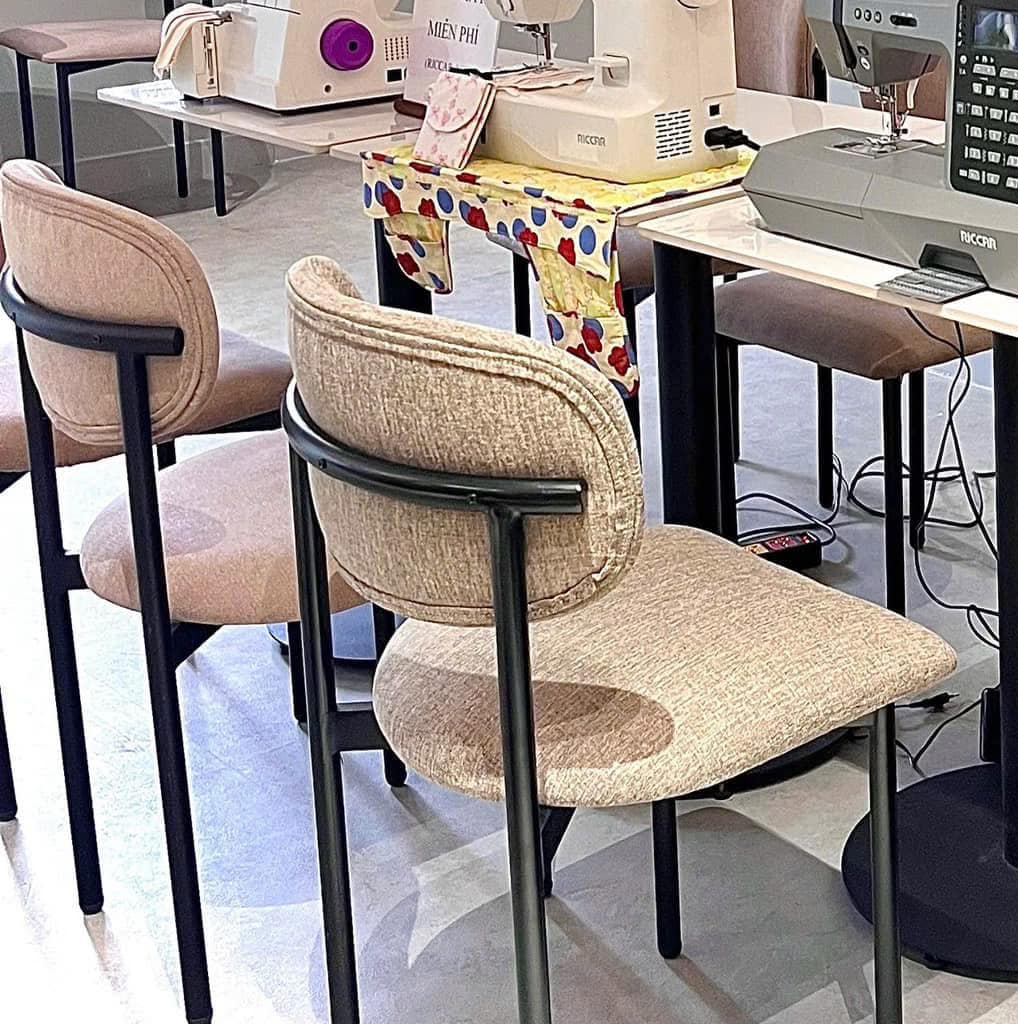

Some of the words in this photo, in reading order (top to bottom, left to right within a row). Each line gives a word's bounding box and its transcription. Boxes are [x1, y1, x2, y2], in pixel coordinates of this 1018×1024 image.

[424, 57, 453, 72] (RICCA
[577, 133, 606, 147] RICCAR
[960, 229, 997, 251] RICCAR
